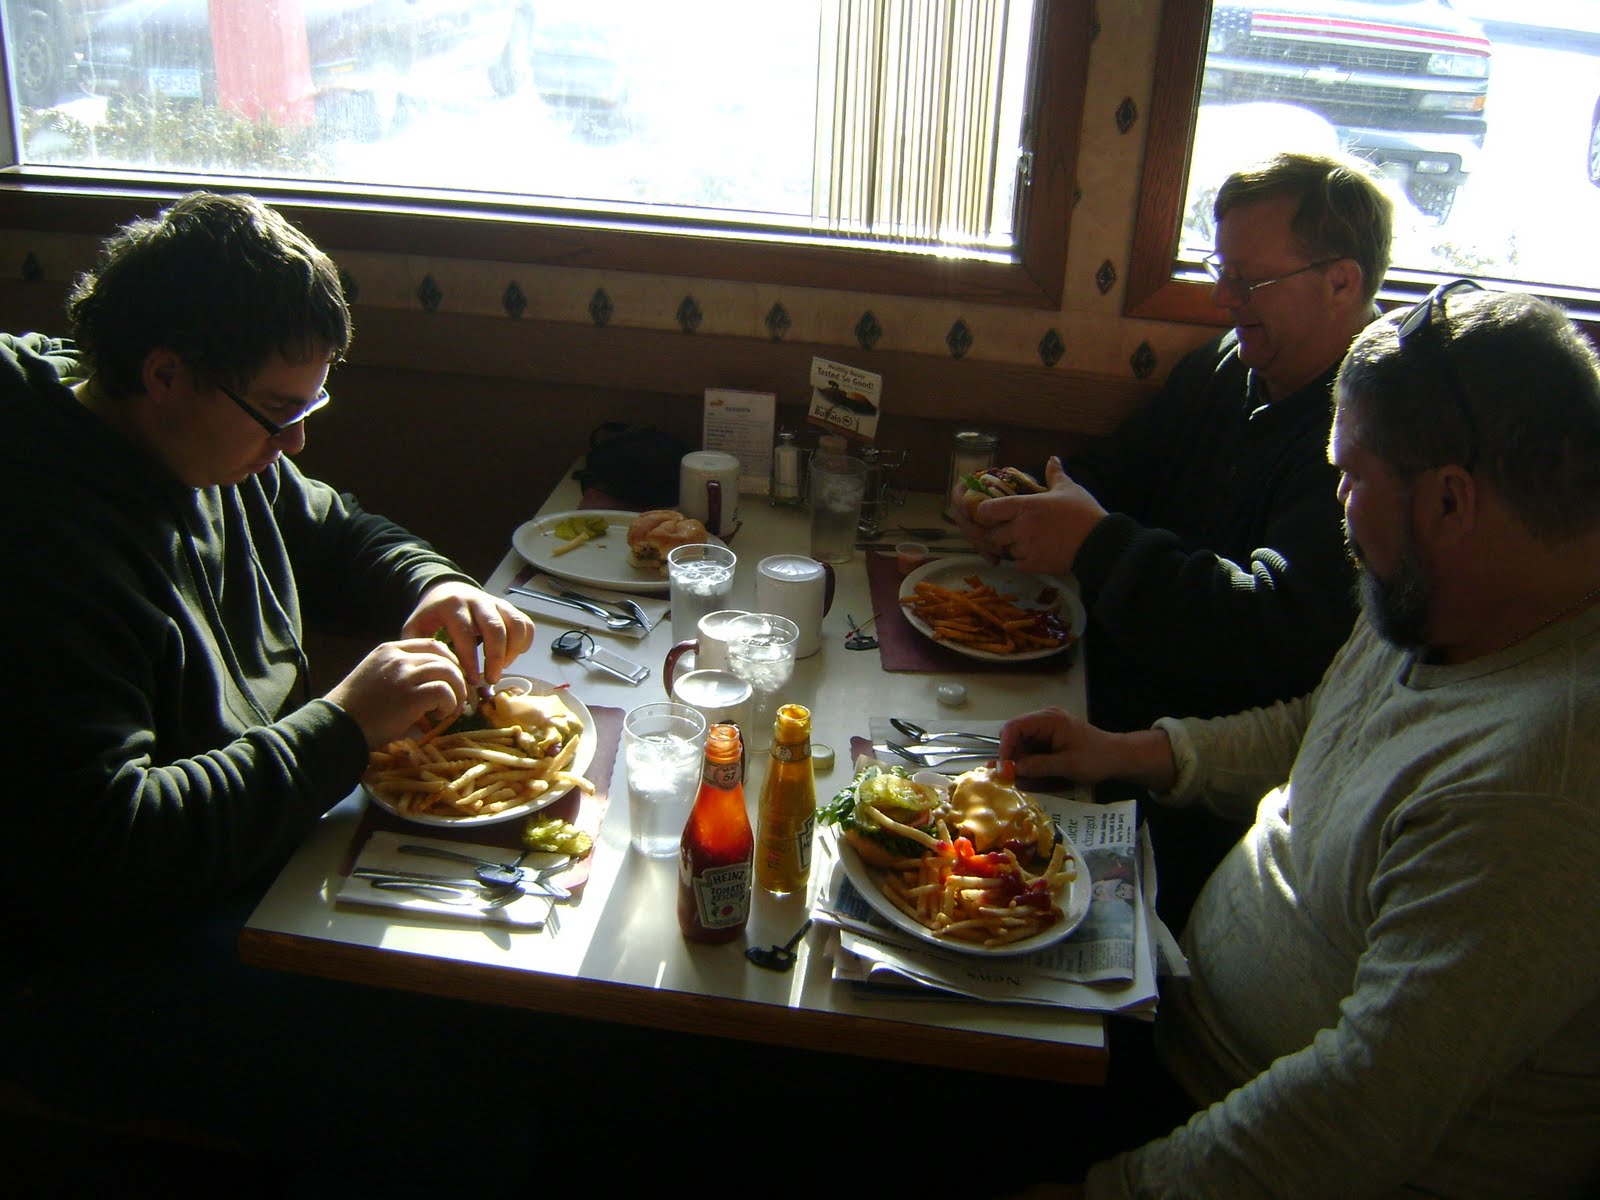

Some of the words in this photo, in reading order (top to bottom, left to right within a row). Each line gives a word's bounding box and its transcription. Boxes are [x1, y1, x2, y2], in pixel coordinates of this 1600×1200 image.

[817, 367, 840, 380] Tasted
[842, 374, 851, 383] So
[852, 378, 874, 389] Good!
[723, 771, 736, 782] 57
[1081, 815, 1097, 847] charged
[712, 871, 745, 884] HEINZ
[711, 882, 746, 895] TOMATO
[967, 972, 1021, 986] News
